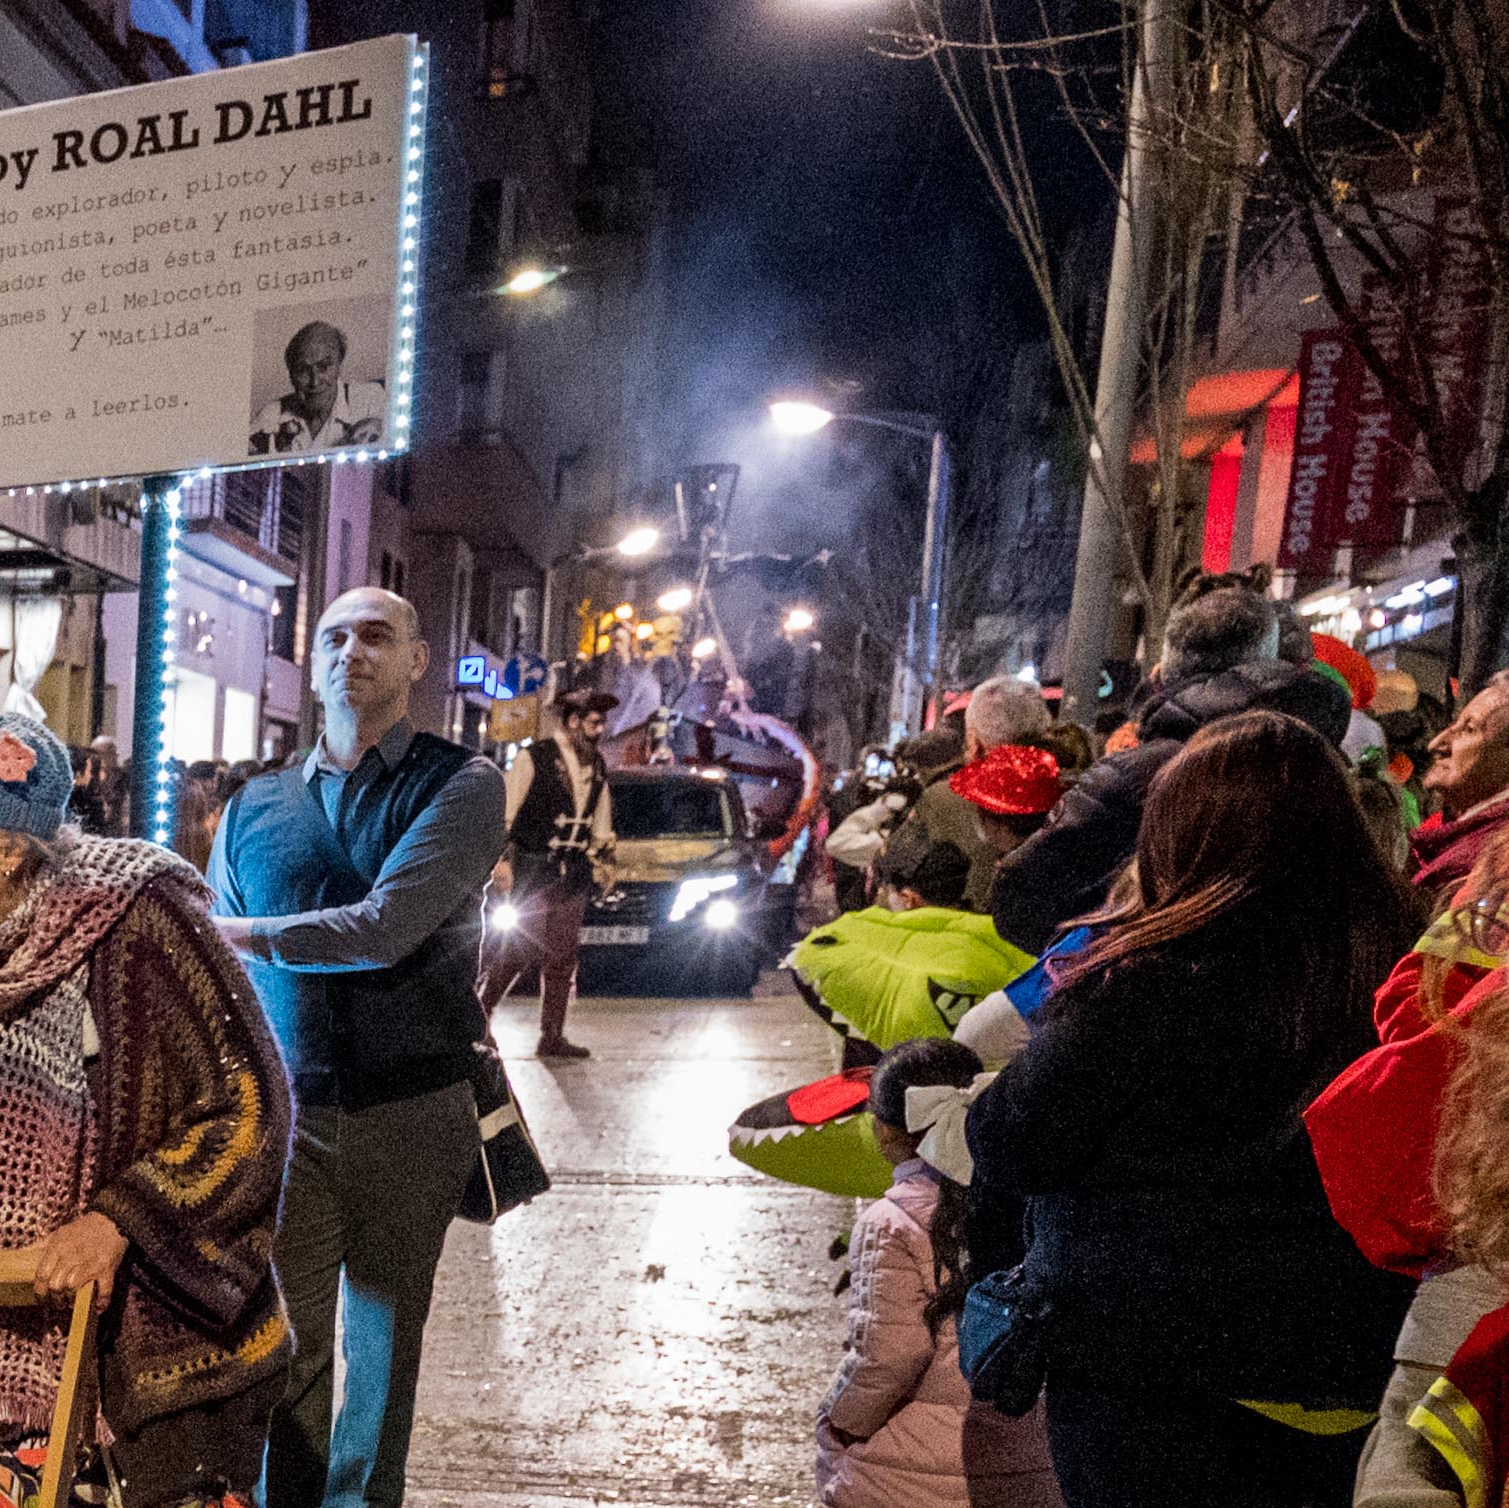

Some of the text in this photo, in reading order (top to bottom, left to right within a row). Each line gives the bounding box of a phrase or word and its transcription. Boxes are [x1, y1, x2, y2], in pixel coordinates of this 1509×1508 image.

[51, 109, 200, 173] ROAL
[213, 78, 373, 144] DAHL
[32, 185, 168, 221] explorador,
[186, 168, 268, 199] piloto
[278, 163, 297, 189] y
[132, 214, 197, 244] poeta
[213, 211, 229, 233] y
[238, 189, 376, 222] novelista.
[61, 266, 86, 284] de
[101, 257, 150, 279] toda
[61, 304, 72, 324] y
[85, 295, 109, 315] el
[69, 329, 87, 352] y
[64, 406, 77, 420] a
[91, 392, 189, 418] leerlos.
[1286, 341, 1343, 556] British House
[1345, 411, 1391, 524] House
